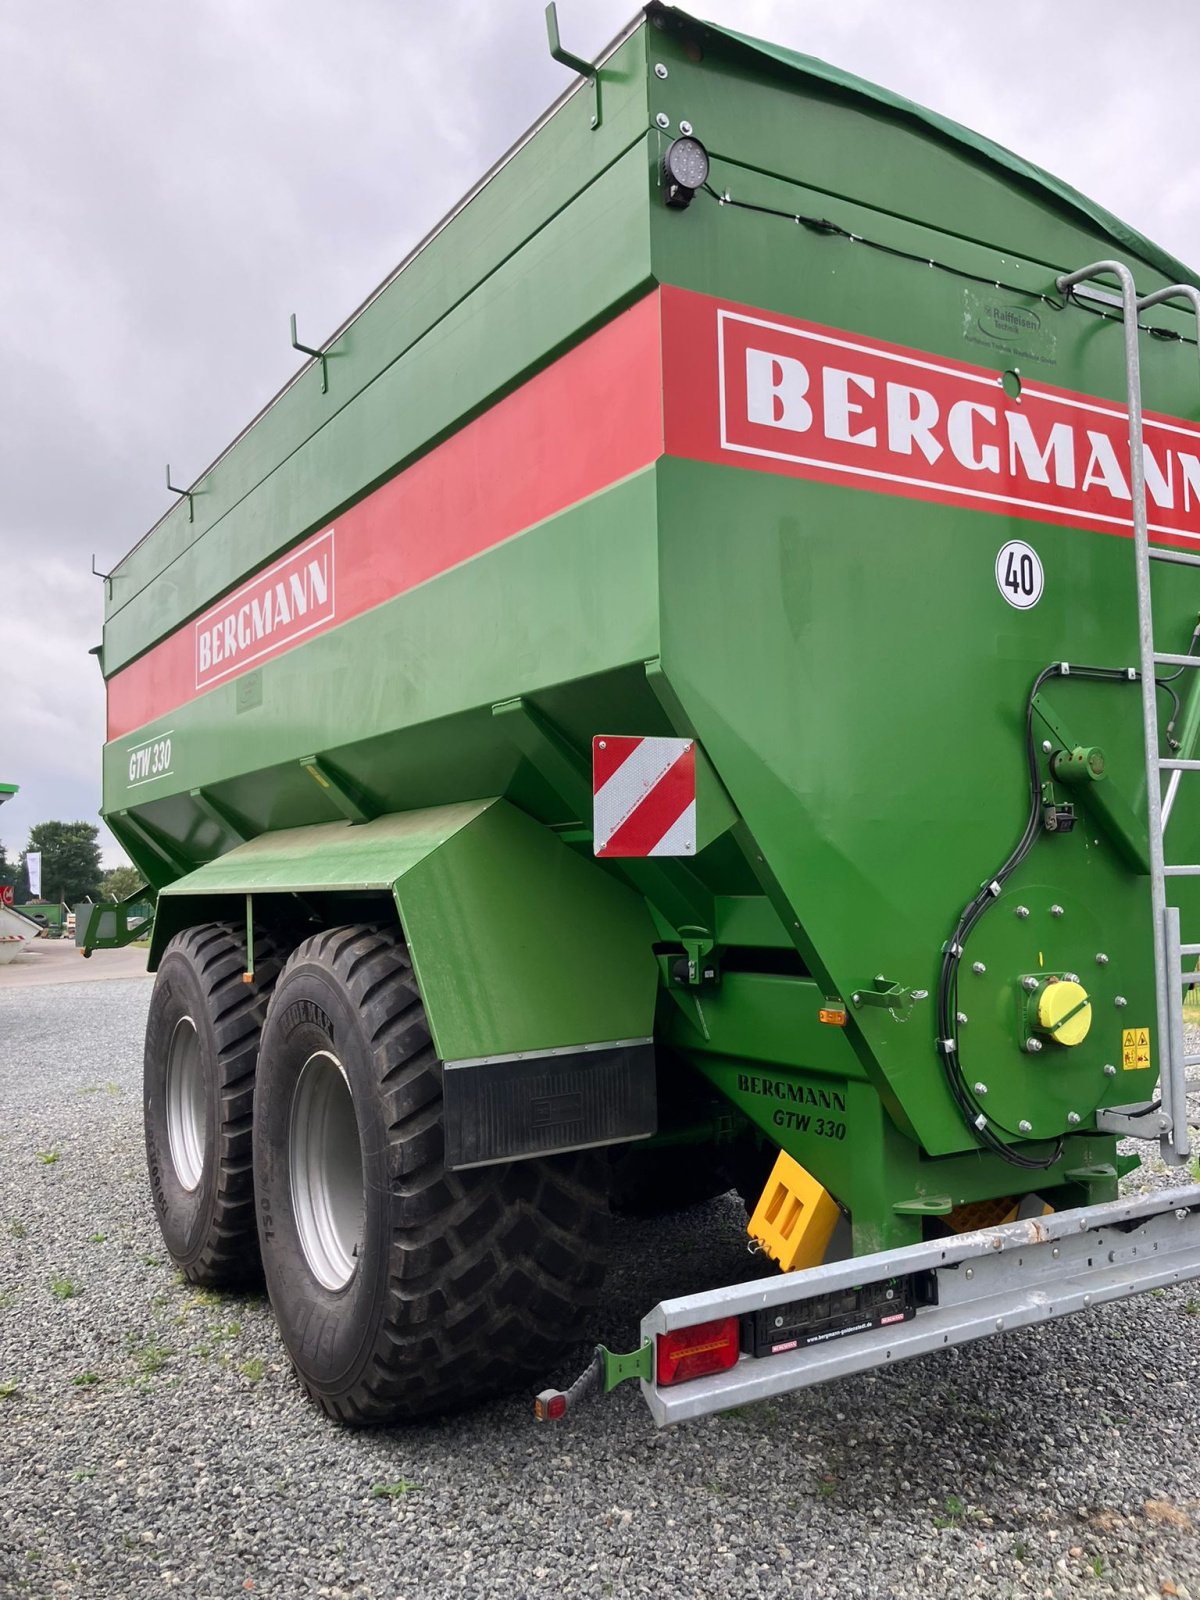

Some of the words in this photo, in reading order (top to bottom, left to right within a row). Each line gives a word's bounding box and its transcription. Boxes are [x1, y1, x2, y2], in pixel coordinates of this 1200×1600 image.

[993, 307, 1037, 330] Raiffeisen
[1004, 551, 1034, 596] 40
[199, 553, 328, 673] BERGMANN
[129, 746, 152, 781] GTW
[152, 738, 171, 774] 330
[737, 1073, 846, 1112] BERGMANN
[773, 1108, 811, 1132] GTW
[814, 1118, 847, 1141] 330
